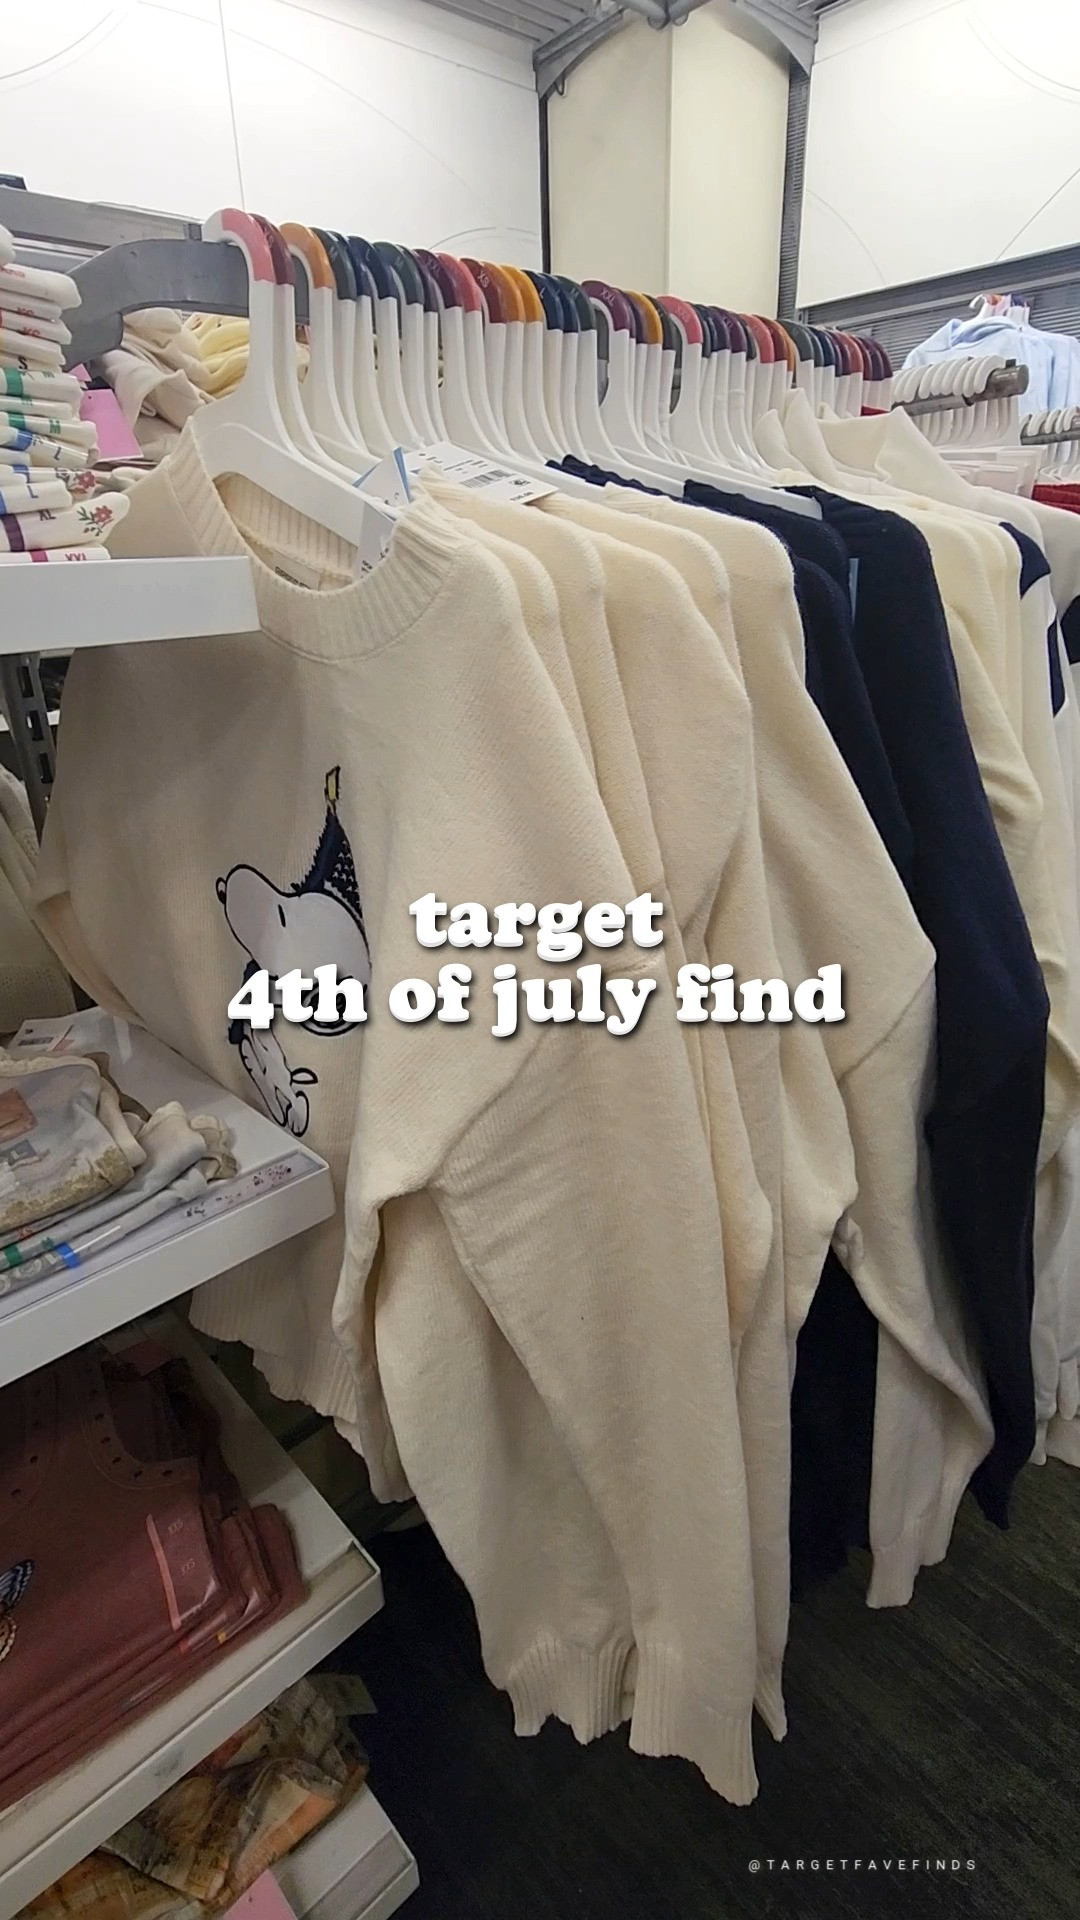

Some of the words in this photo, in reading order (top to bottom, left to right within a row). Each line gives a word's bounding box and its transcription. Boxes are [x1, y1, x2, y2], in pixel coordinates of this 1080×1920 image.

[476, 271, 489, 289] XS
[599, 287, 615, 307] XXL
[17, 355, 28, 370] S
[48, 419, 62, 435] M
[53, 446, 63, 461] L
[27, 485, 39, 499] L
